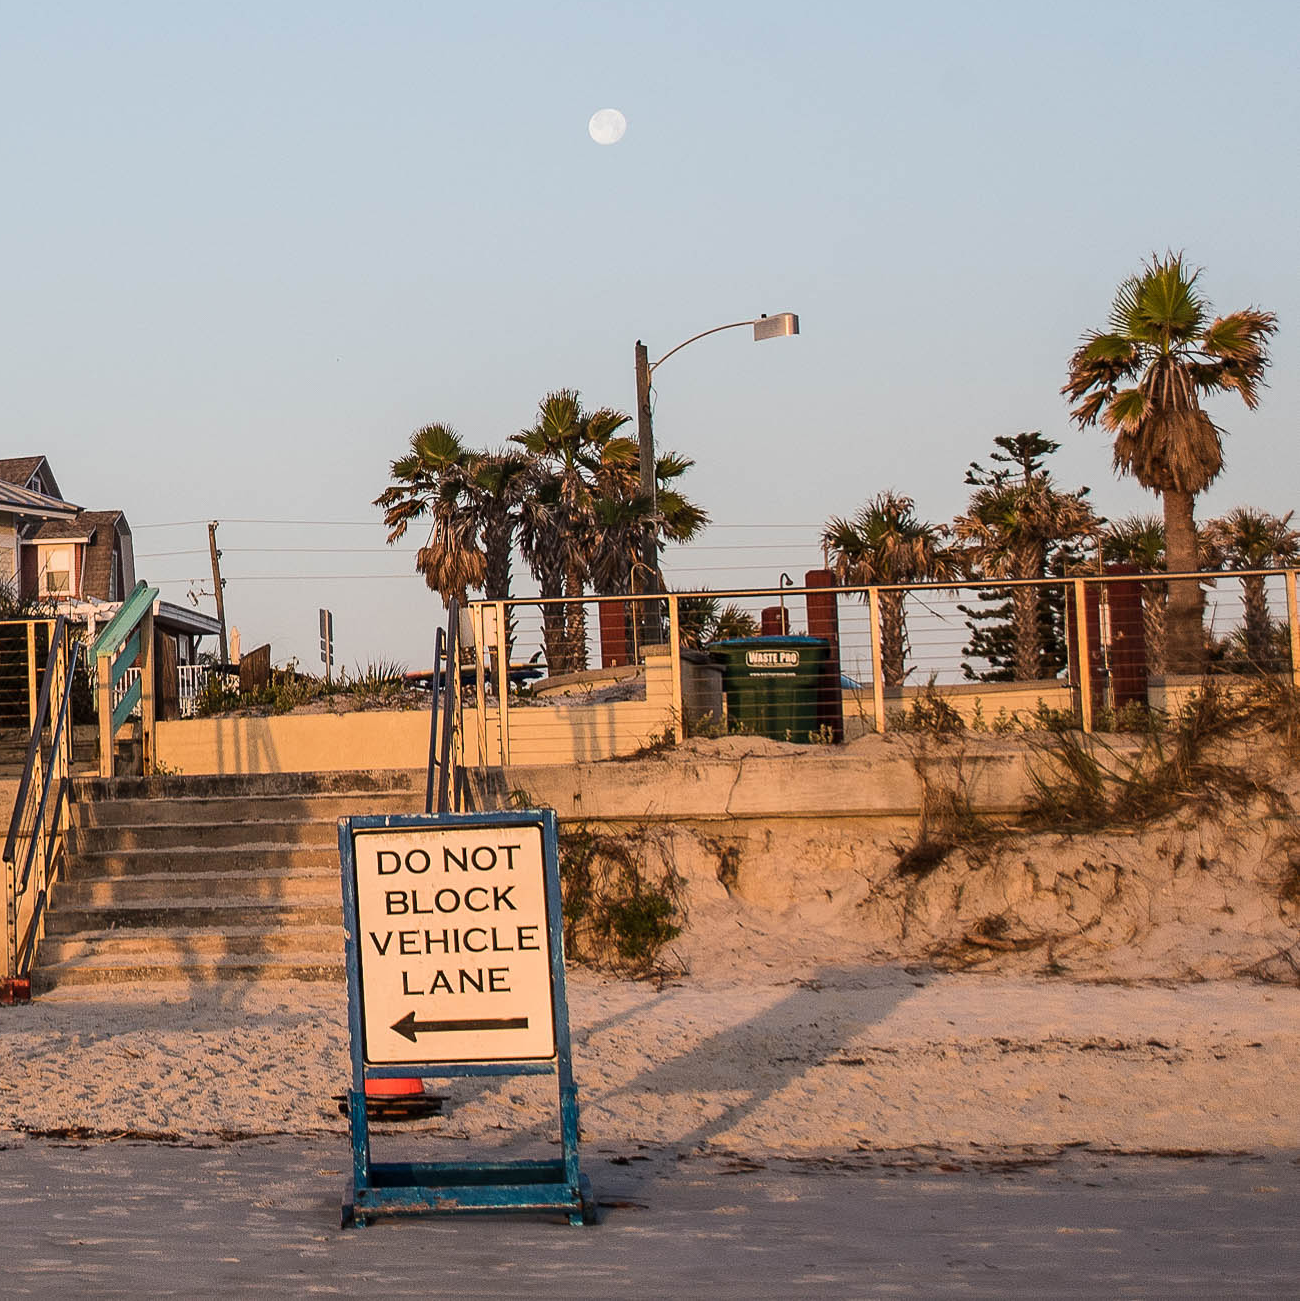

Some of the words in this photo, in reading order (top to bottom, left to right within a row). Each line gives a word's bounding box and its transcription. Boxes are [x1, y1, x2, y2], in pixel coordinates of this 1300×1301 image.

[748, 652, 778, 663] WASTE
[780, 652, 797, 663] PRO
[376, 849, 431, 875] DO
[443, 844, 521, 872] NOT
[385, 886, 518, 915] BLOCK
[369, 926, 541, 956] VEHICLE
[402, 967, 511, 996] LANE
